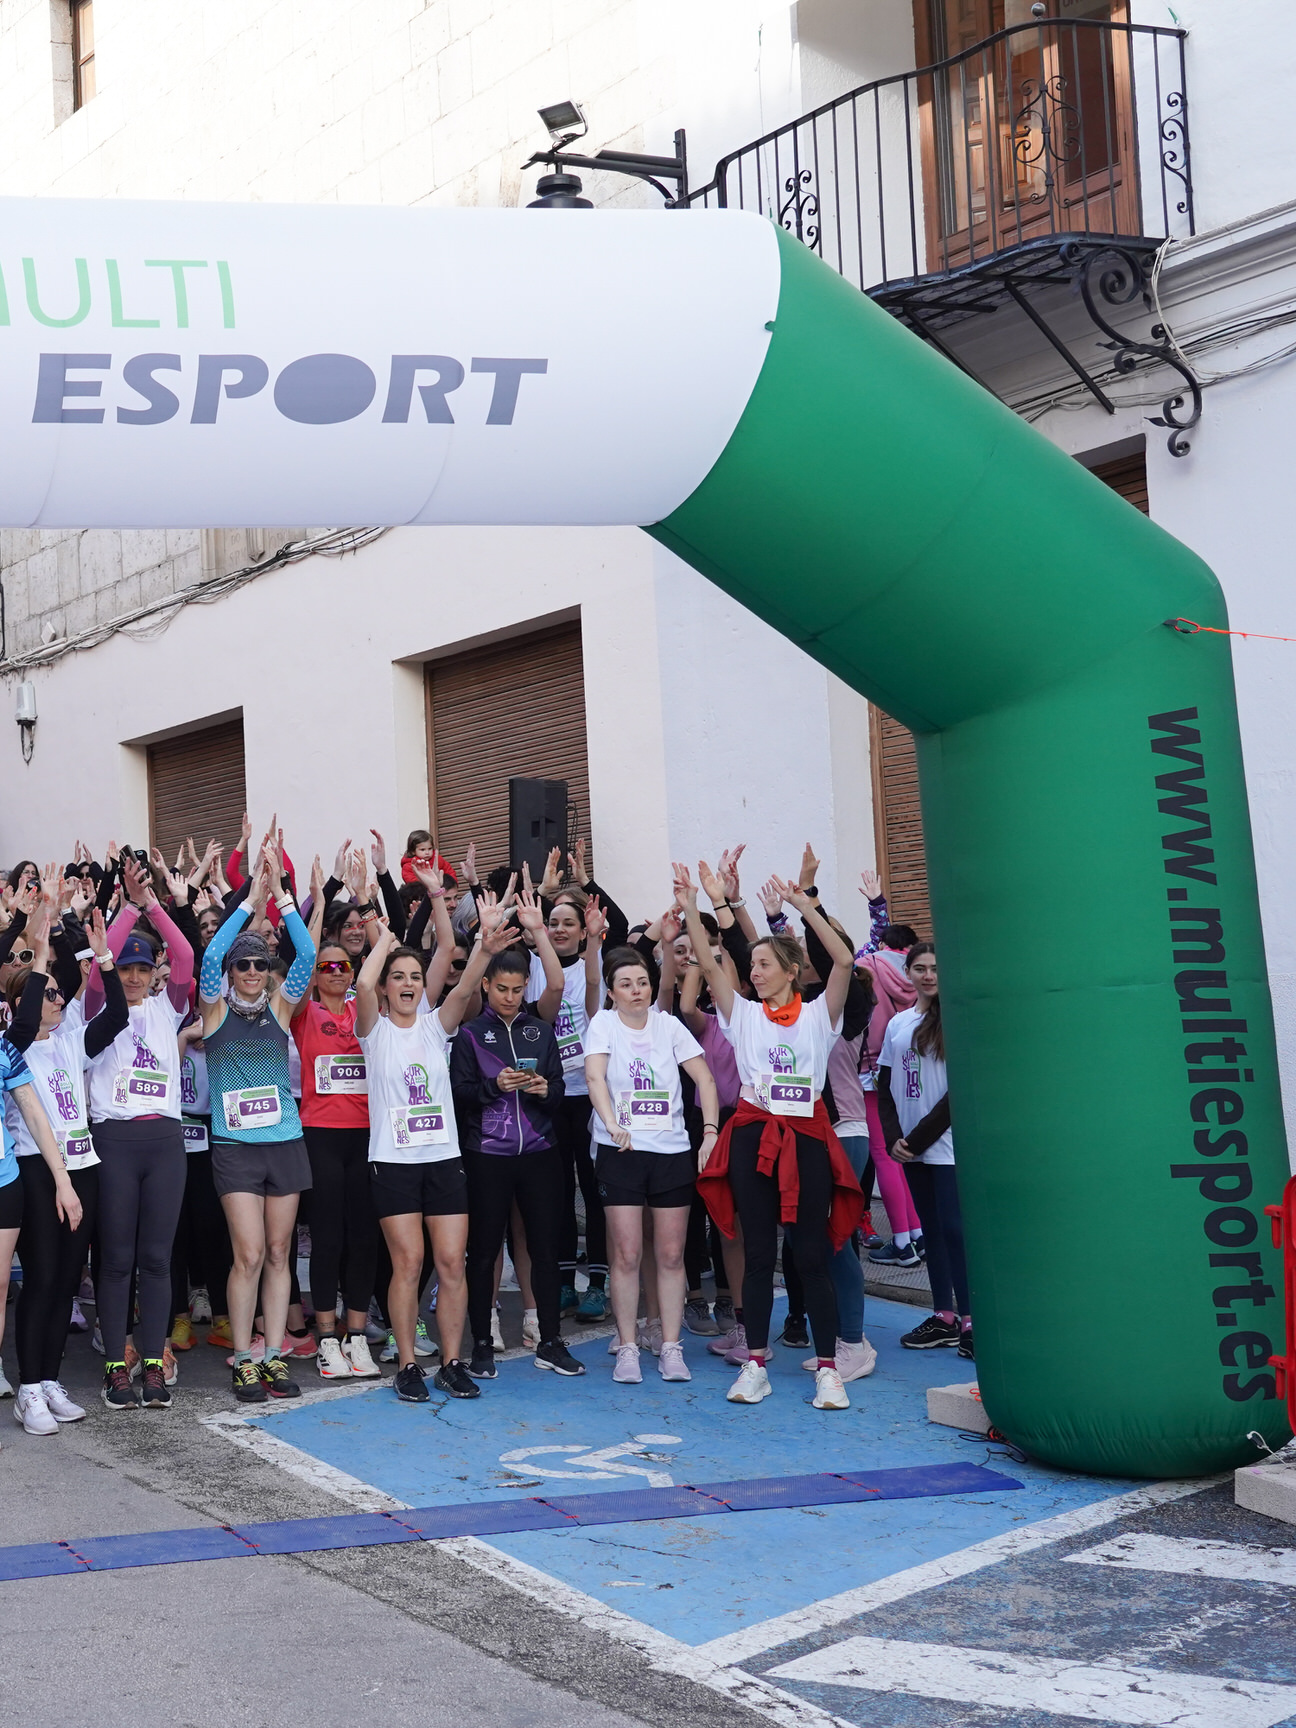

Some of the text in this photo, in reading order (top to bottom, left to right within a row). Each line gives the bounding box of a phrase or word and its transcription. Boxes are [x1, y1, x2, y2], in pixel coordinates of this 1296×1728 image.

[32, 353, 548, 425] ESPORT
[1147, 706, 1276, 1402] www.multiesport.es
[337, 1067, 360, 1077] 906
[136, 1082, 159, 1094] 589
[779, 1088, 803, 1099] 149
[246, 1100, 271, 1112] 745
[638, 1103, 663, 1112] 428
[415, 1118, 437, 1129] 427
[181, 1128, 198, 1137] 66
